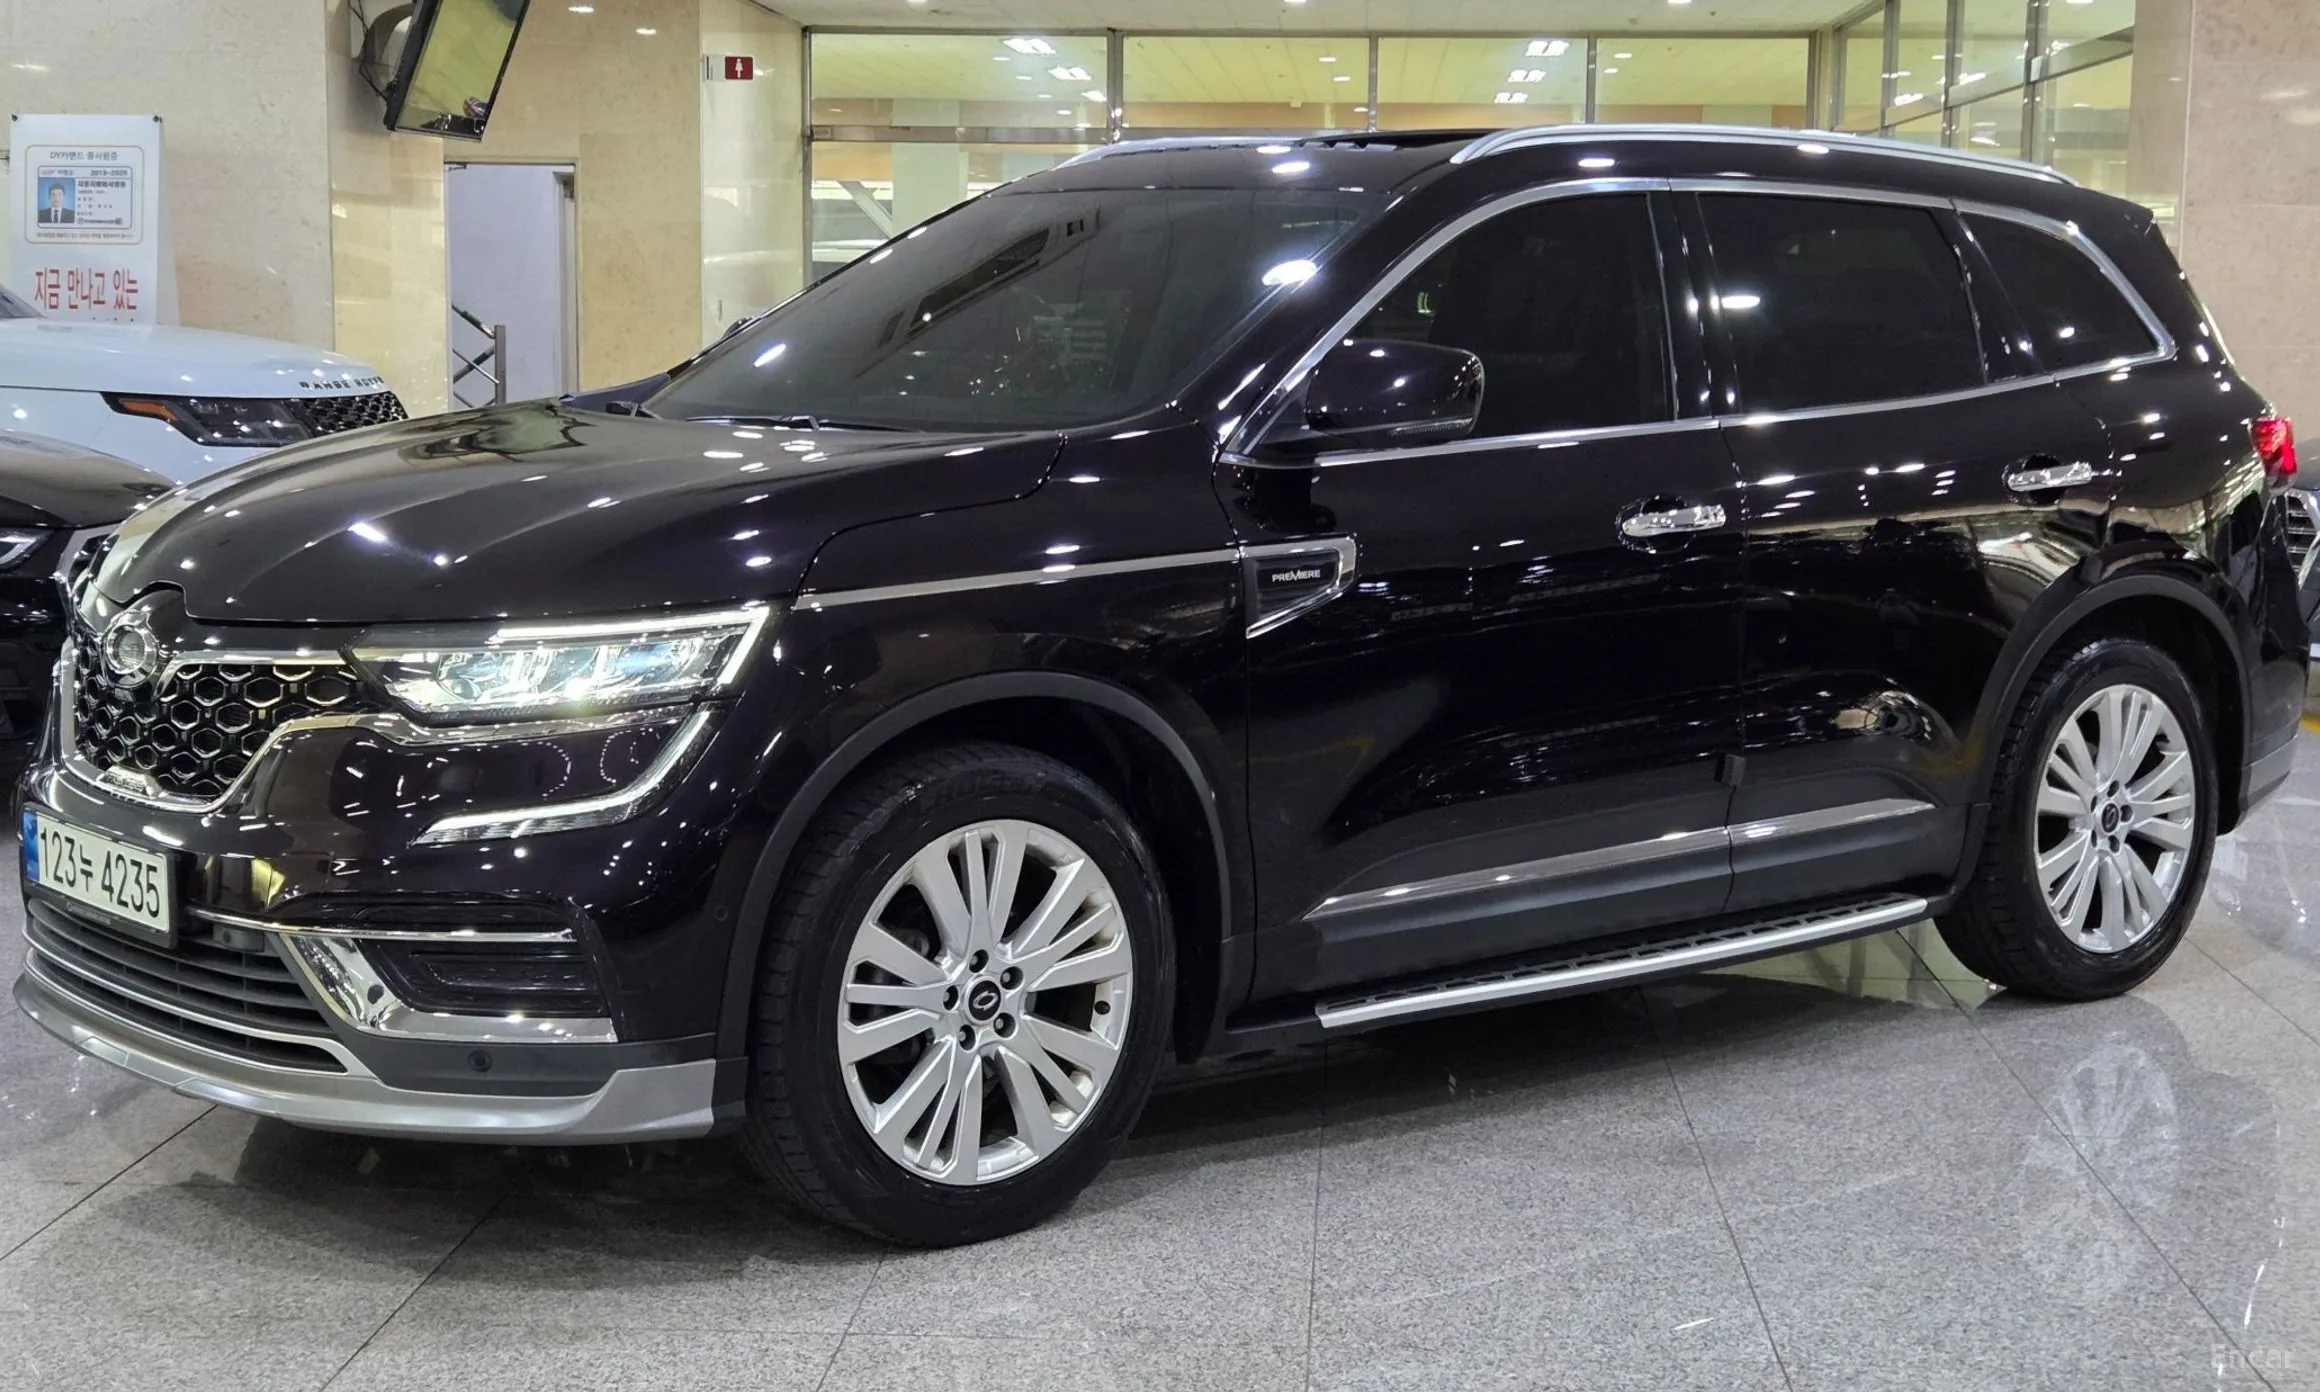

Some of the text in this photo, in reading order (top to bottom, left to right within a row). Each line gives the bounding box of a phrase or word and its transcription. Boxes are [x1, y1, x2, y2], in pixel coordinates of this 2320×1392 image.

[35, 267, 138, 310] 지금 만나고 있는
[1272, 569, 1321, 582] PREMIERE
[40, 827, 160, 918] 123누 4235
